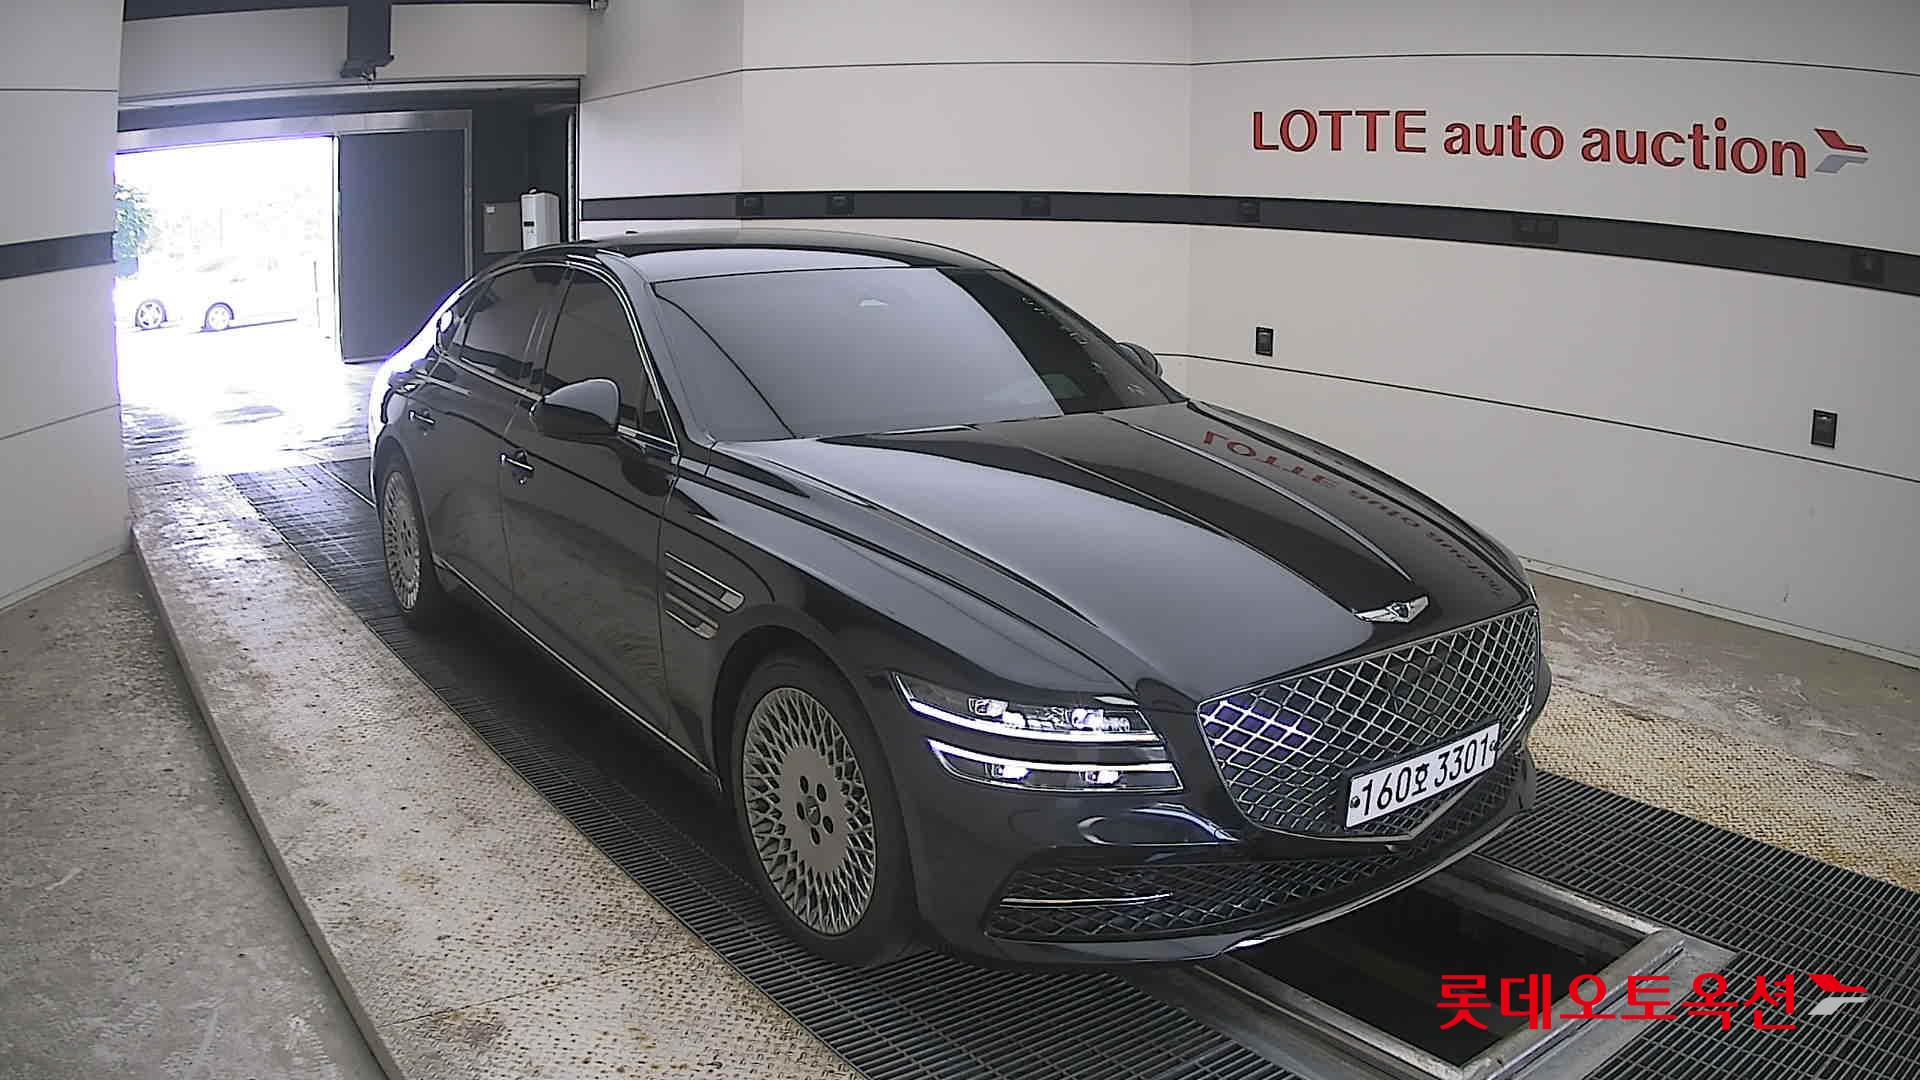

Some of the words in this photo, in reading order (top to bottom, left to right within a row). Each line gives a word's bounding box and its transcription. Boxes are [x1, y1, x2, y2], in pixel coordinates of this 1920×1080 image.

[1252, 109, 1427, 153] LOTTE
[1443, 114, 1565, 160] auto
[1581, 117, 1807, 179] auction
[1361, 762, 1430, 817] 160호
[1434, 732, 1490, 788] 3301
